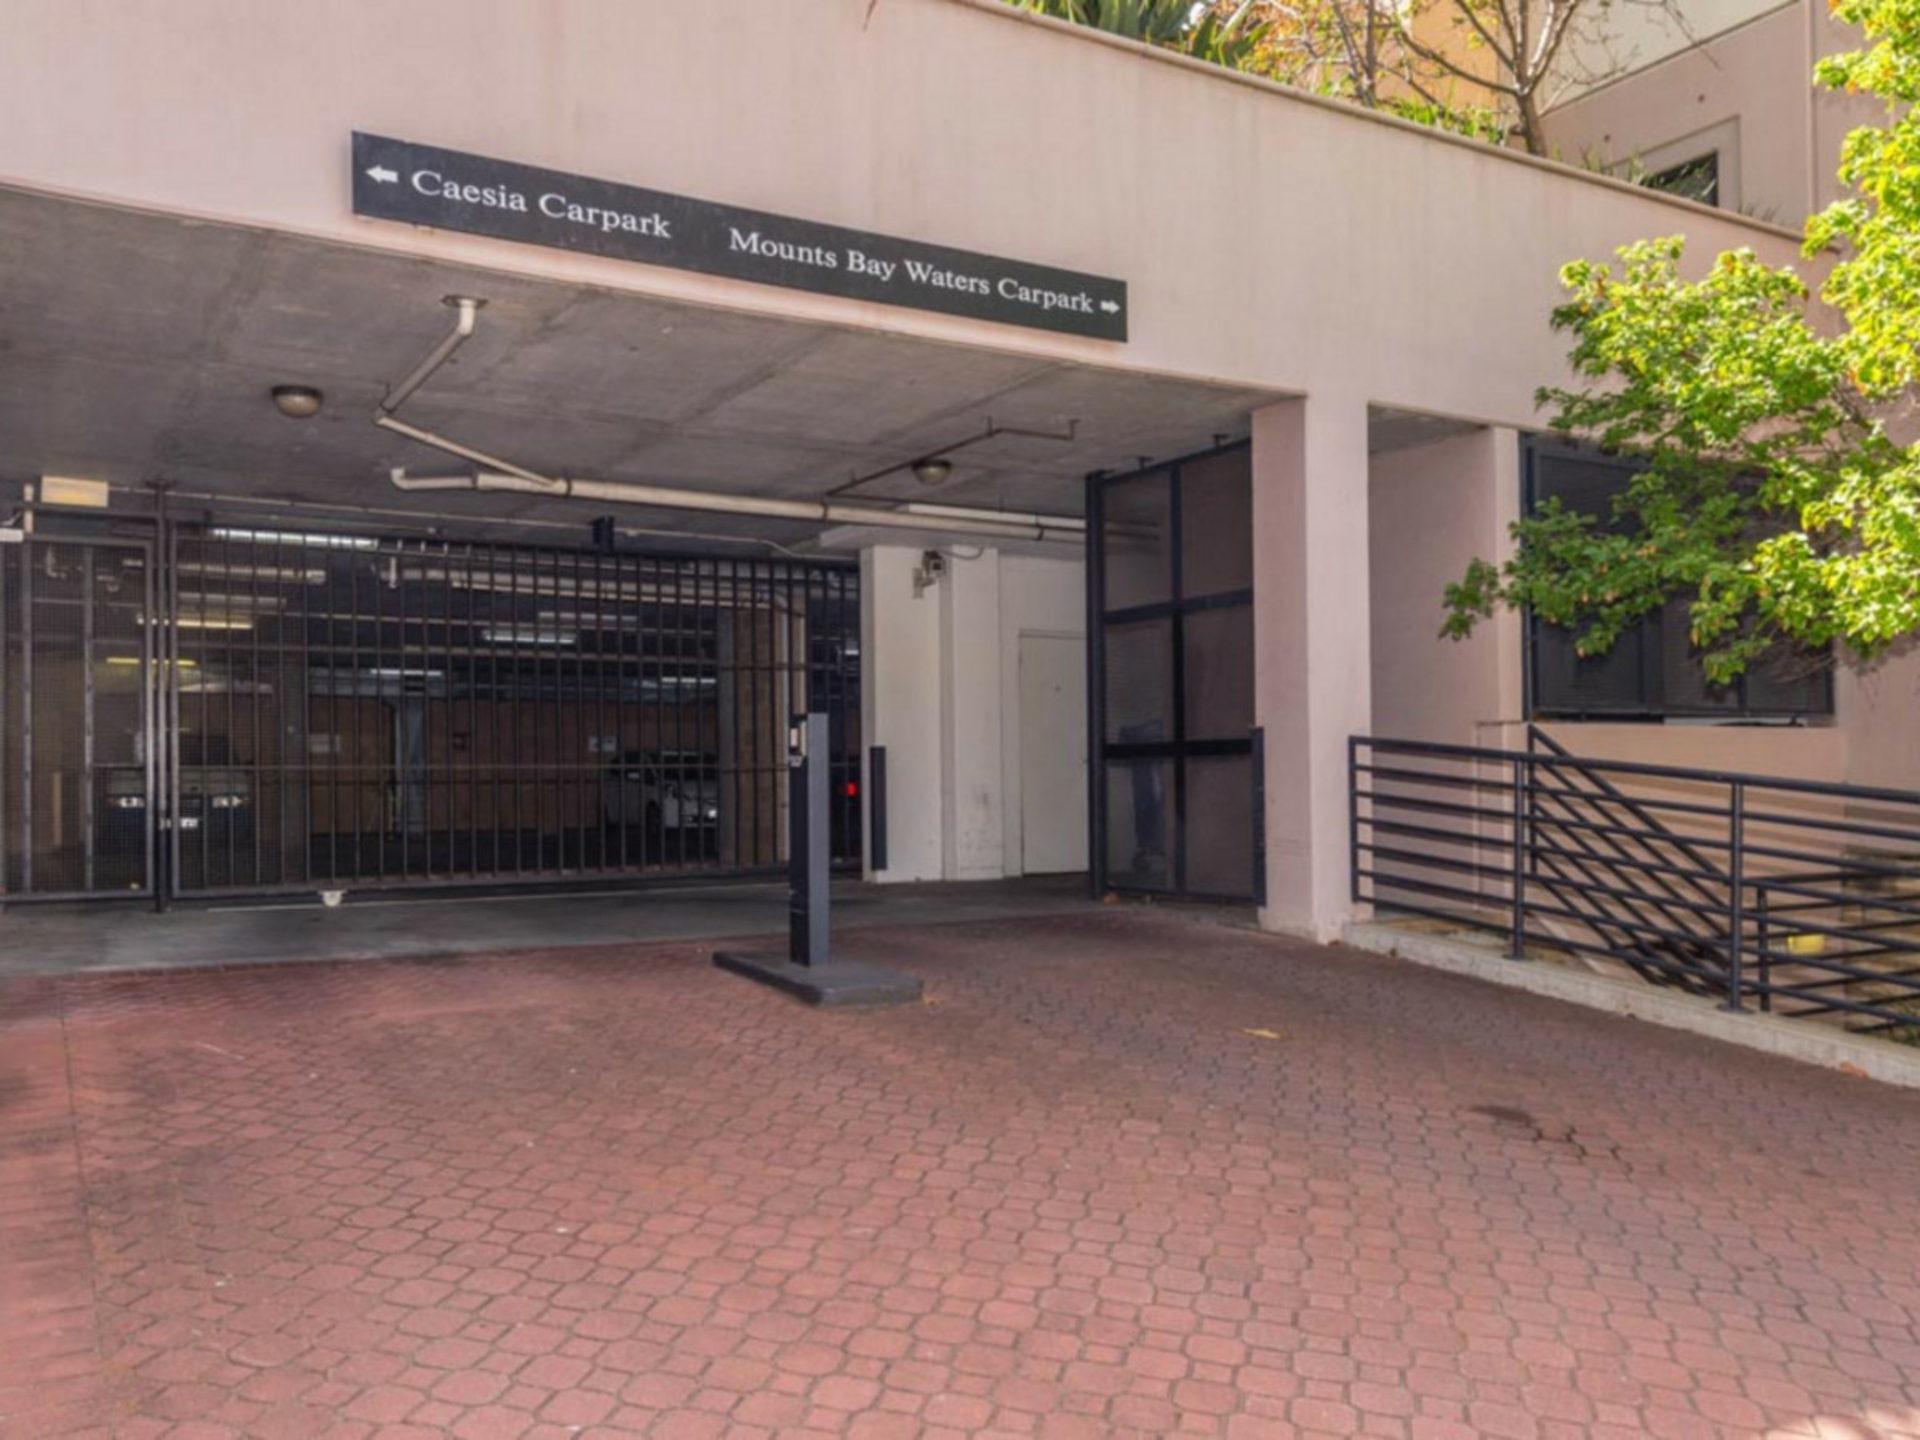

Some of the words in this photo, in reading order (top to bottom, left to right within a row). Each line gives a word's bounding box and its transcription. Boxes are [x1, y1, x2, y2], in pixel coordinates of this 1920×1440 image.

[410, 170, 528, 213] Caesia
[538, 192, 671, 239] Carpark
[729, 227, 838, 268] Mounts
[846, 249, 897, 282] Bay
[903, 259, 991, 295] Waters
[997, 277, 1094, 313] Carpark
